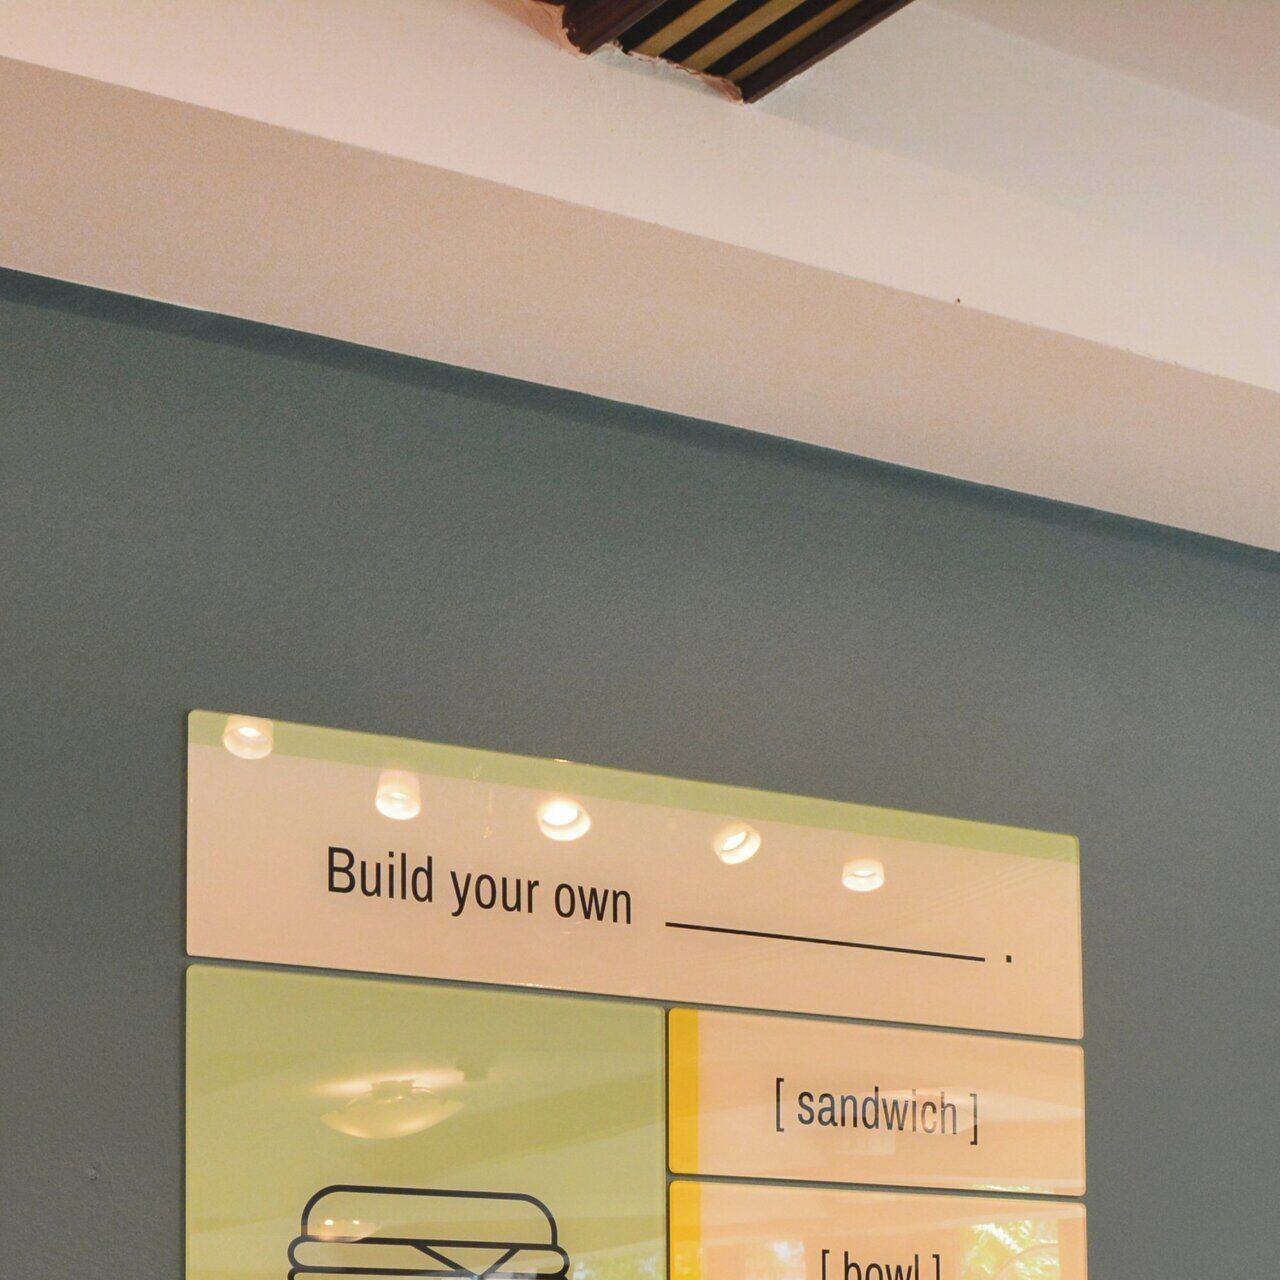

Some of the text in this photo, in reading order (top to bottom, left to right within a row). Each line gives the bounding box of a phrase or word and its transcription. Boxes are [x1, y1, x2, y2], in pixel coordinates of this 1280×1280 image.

[328, 846, 433, 903] Build
[450, 870, 540, 917] your
[554, 883, 631, 925] own
[797, 1086, 958, 1135] sandwich
